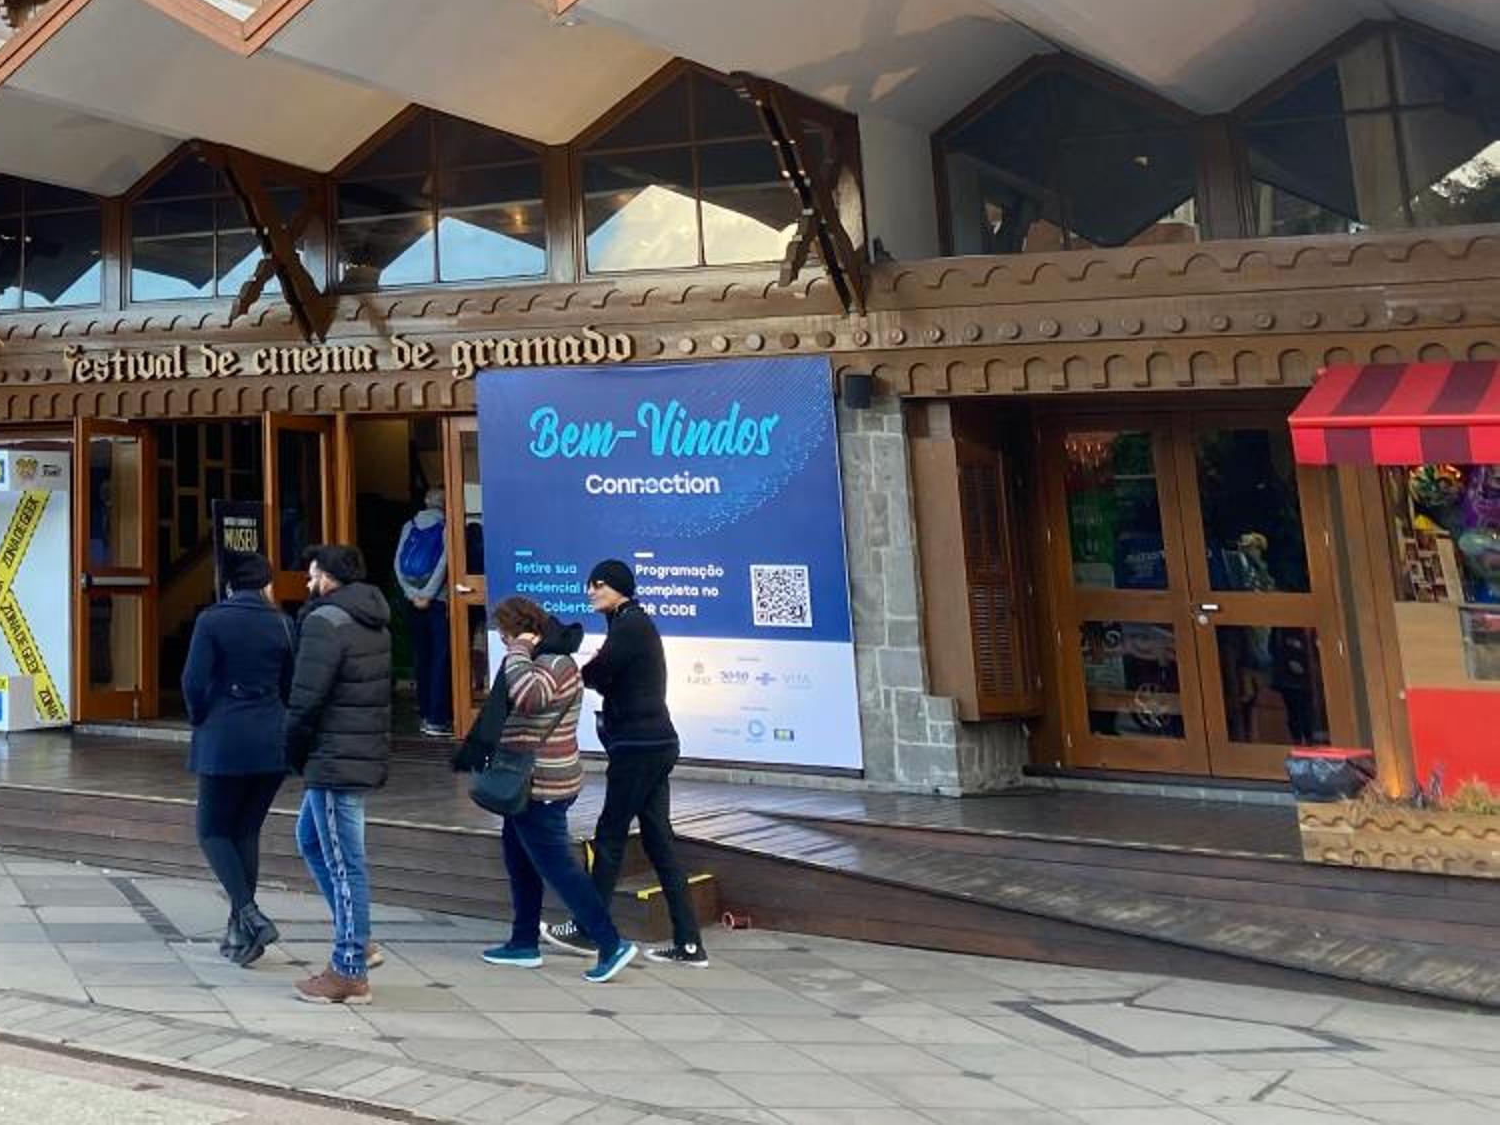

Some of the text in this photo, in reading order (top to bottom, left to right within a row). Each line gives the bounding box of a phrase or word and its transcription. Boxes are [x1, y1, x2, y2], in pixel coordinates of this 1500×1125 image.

[200, 344, 240, 379] de
[253, 344, 374, 376] cinema
[391, 334, 436, 371] de
[451, 325, 632, 379] gramado
[529, 399, 780, 458] Bem-Vindos
[585, 471, 721, 494] Connection
[515, 562, 577, 574] Retire sua
[635, 564, 724, 579] Programação
[515, 581, 581, 594] credencial
[636, 584, 719, 599] completa no
[660, 604, 697, 616] CODE
